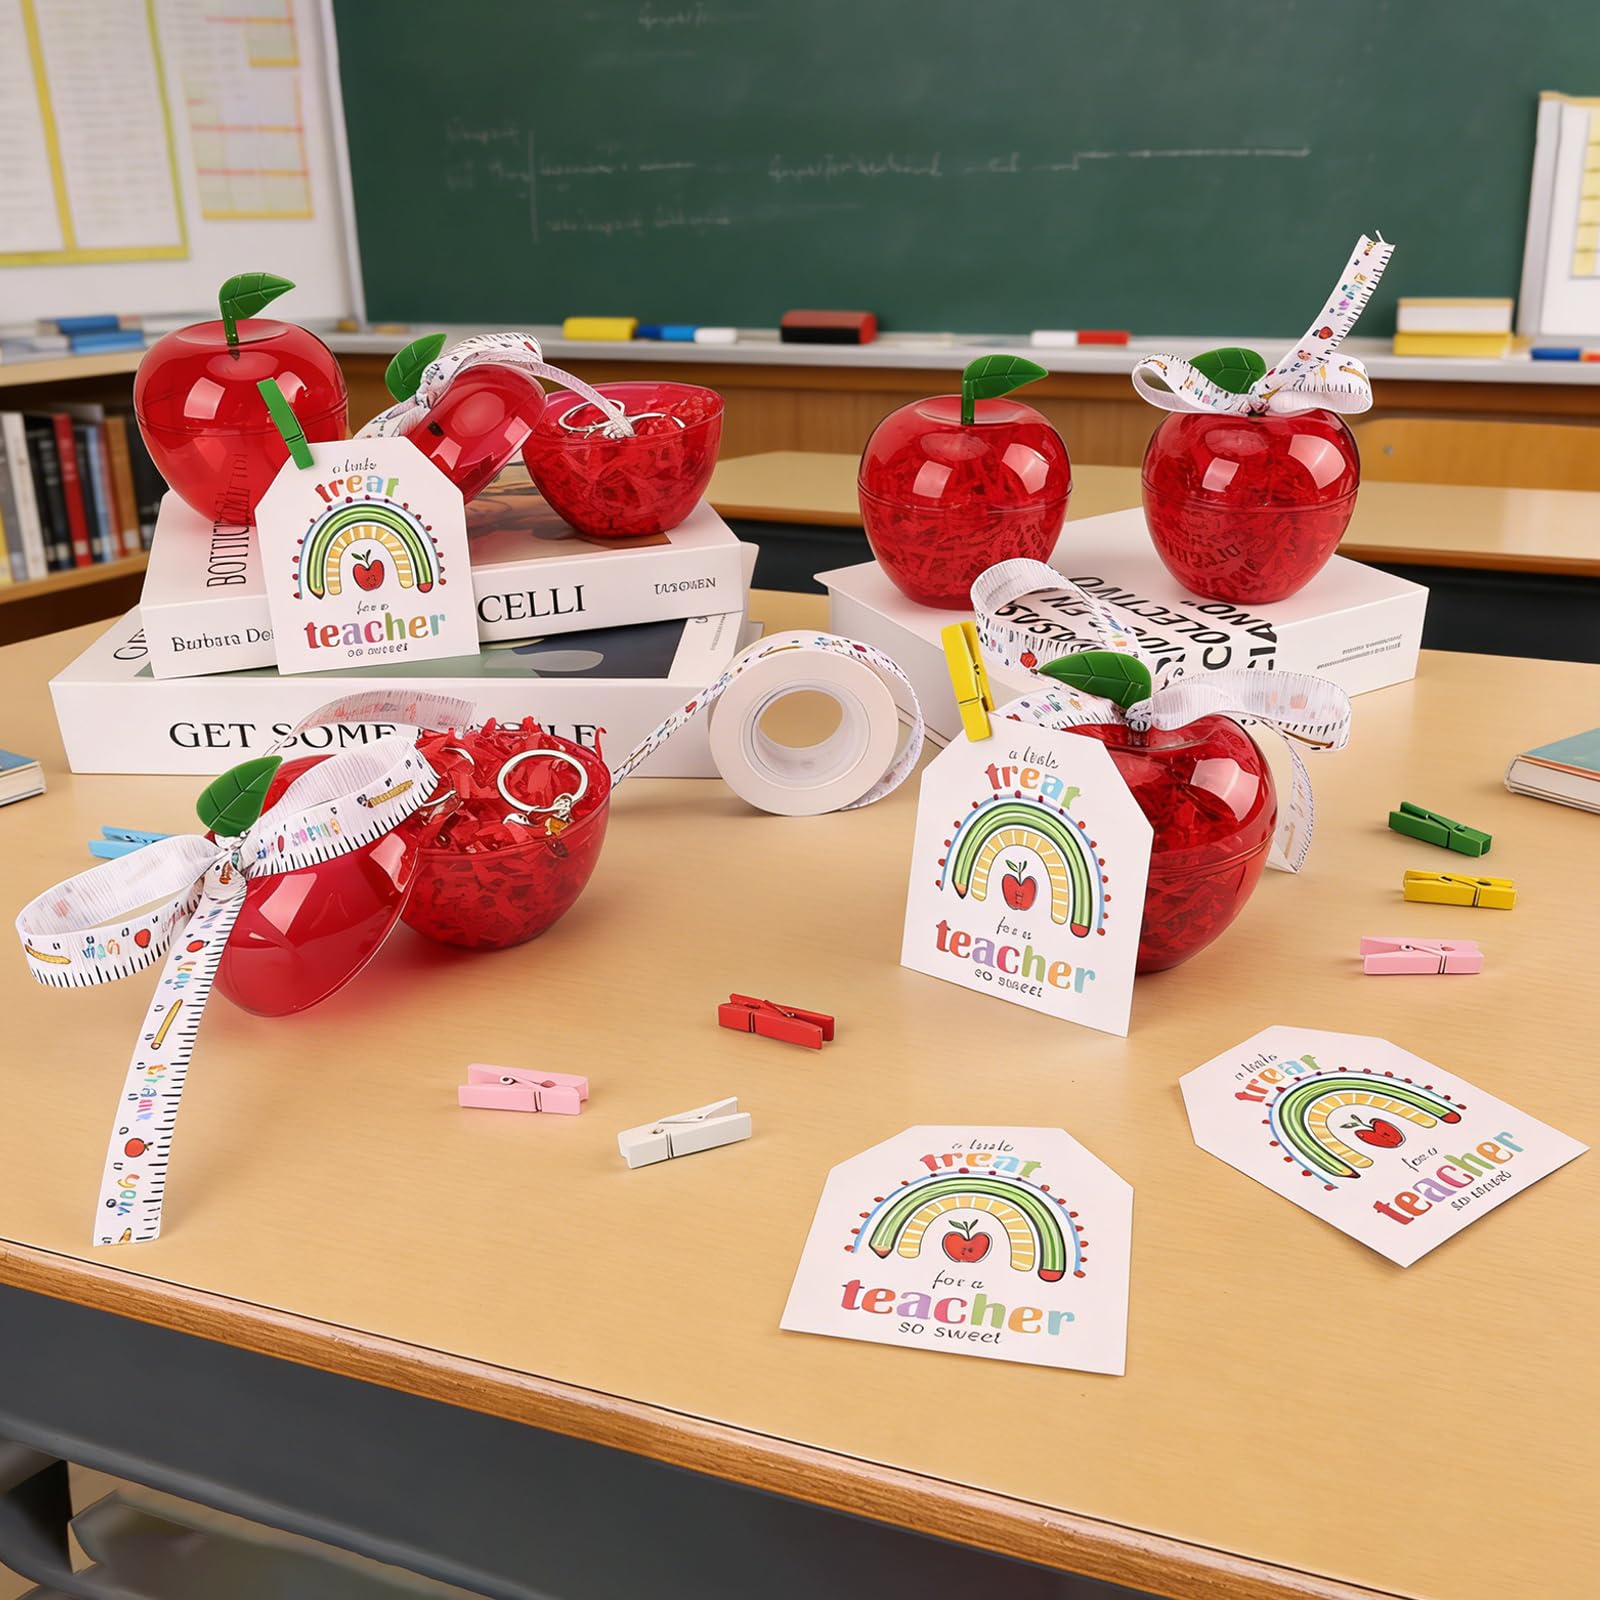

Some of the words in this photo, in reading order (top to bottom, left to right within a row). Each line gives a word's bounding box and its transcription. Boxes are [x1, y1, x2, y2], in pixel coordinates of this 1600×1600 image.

[304, 611, 446, 649] teacher
[168, 721, 256, 749] GET
[271, 722, 397, 750] SOME
[935, 919, 1096, 994] teacher
[1372, 1131, 1525, 1226] teacher
[841, 1279, 1076, 1336] teacher
